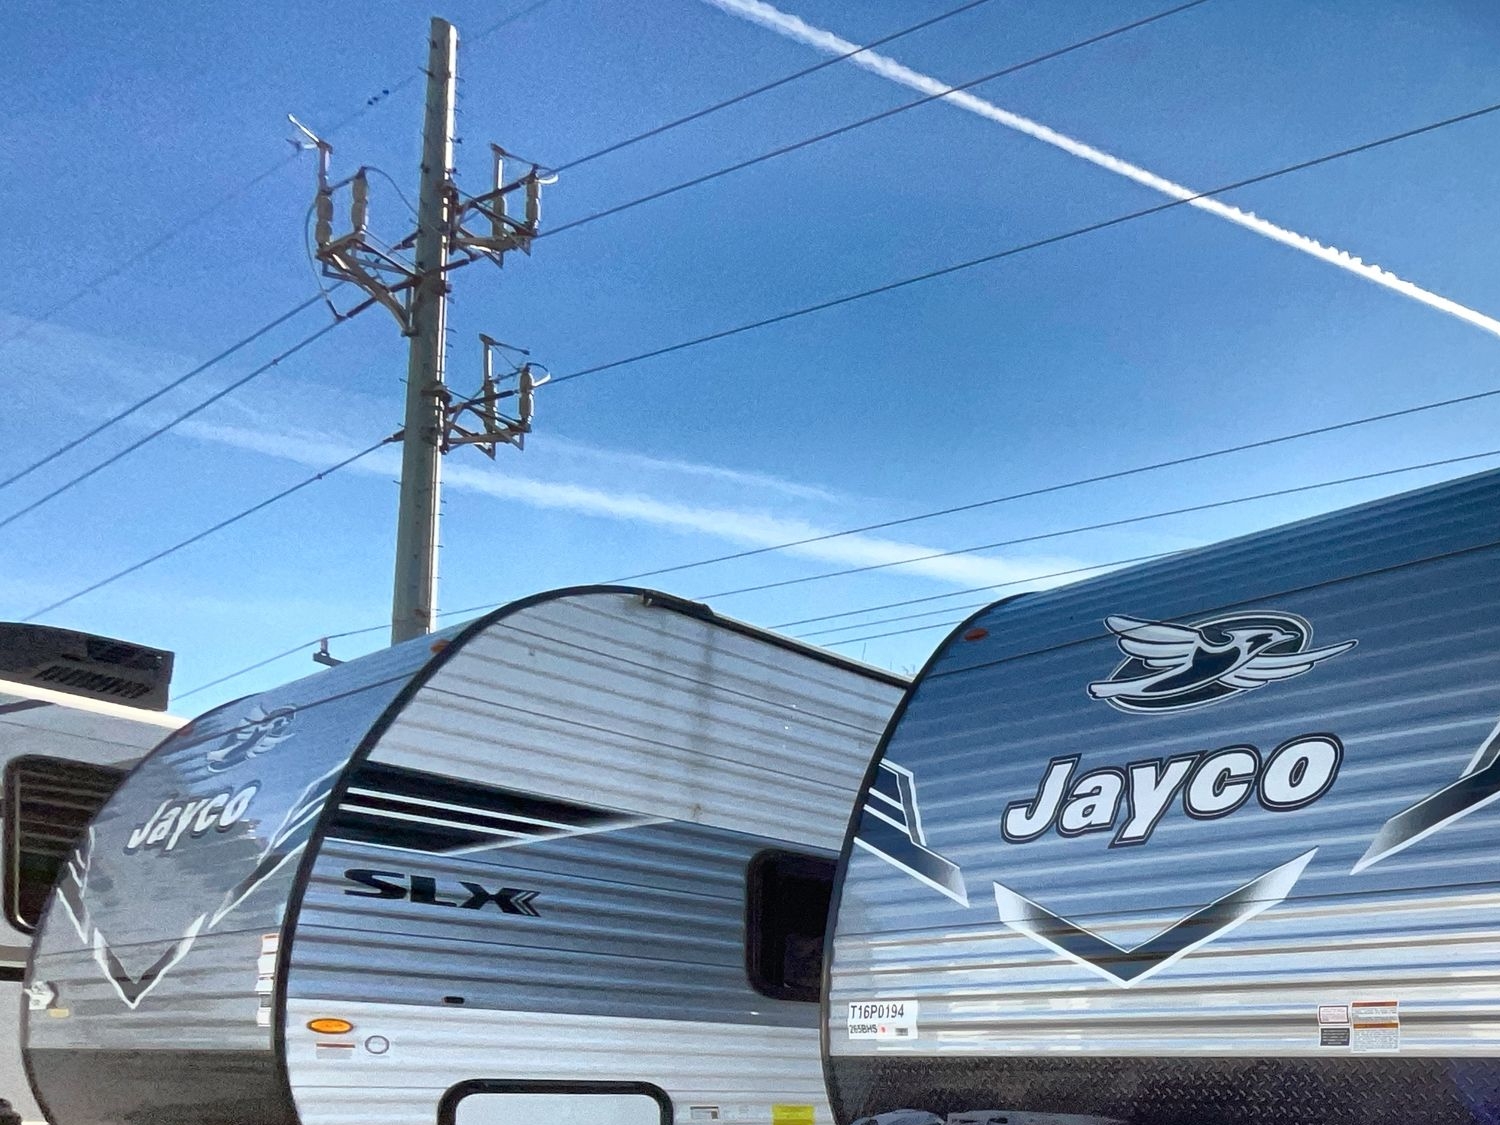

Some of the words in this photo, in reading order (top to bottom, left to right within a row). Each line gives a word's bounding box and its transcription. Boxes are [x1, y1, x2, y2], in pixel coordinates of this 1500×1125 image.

[124, 780, 262, 856] Jayco
[1001, 732, 1344, 849] Jayco
[344, 868, 541, 917] SLX
[850, 1003, 904, 1019] T16P0194
